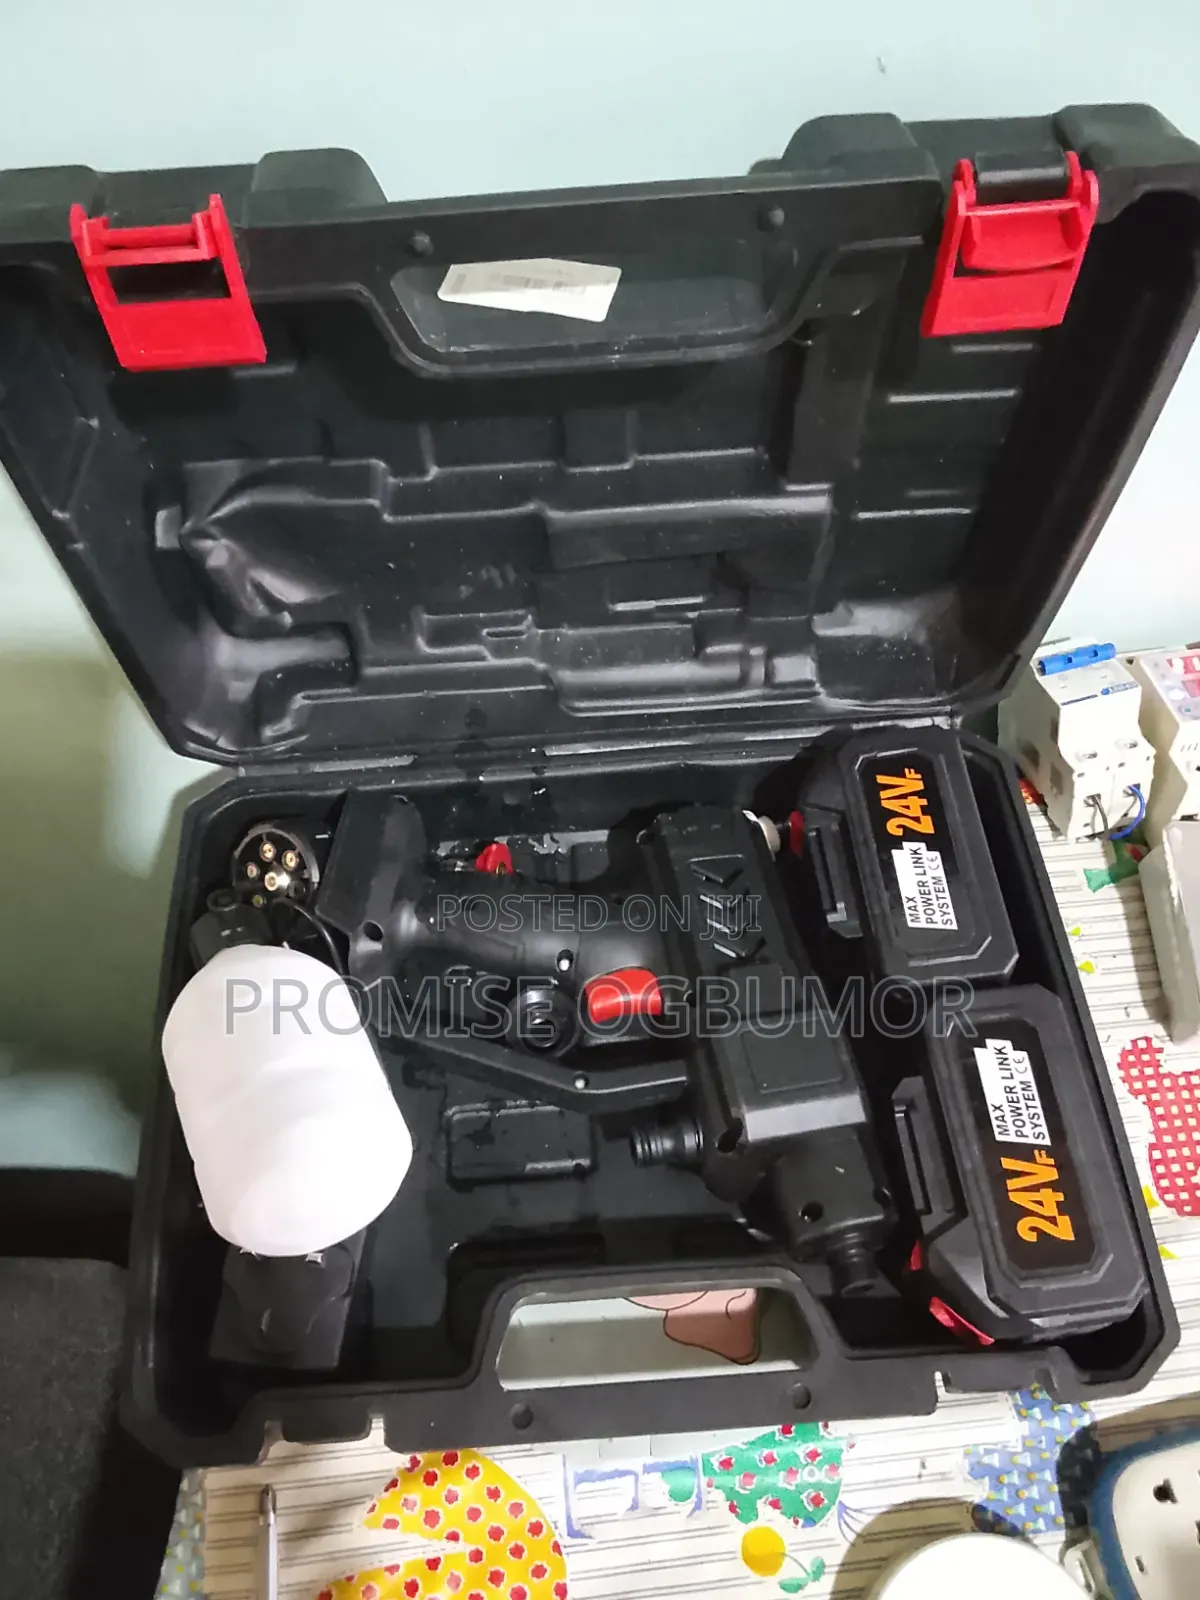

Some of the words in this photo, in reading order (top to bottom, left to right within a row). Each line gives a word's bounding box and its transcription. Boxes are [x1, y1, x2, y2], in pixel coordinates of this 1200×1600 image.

[909, 847, 927, 876] LINK
[906, 896, 921, 924] MAX
[917, 880, 938, 925] POWER
[932, 875, 953, 926] SYSTEM
[994, 1045, 1013, 1080] LINK
[991, 1103, 1010, 1136] MAX
[1004, 1085, 1029, 1139] POWER
[1021, 1080, 1045, 1140] SYSTEM
